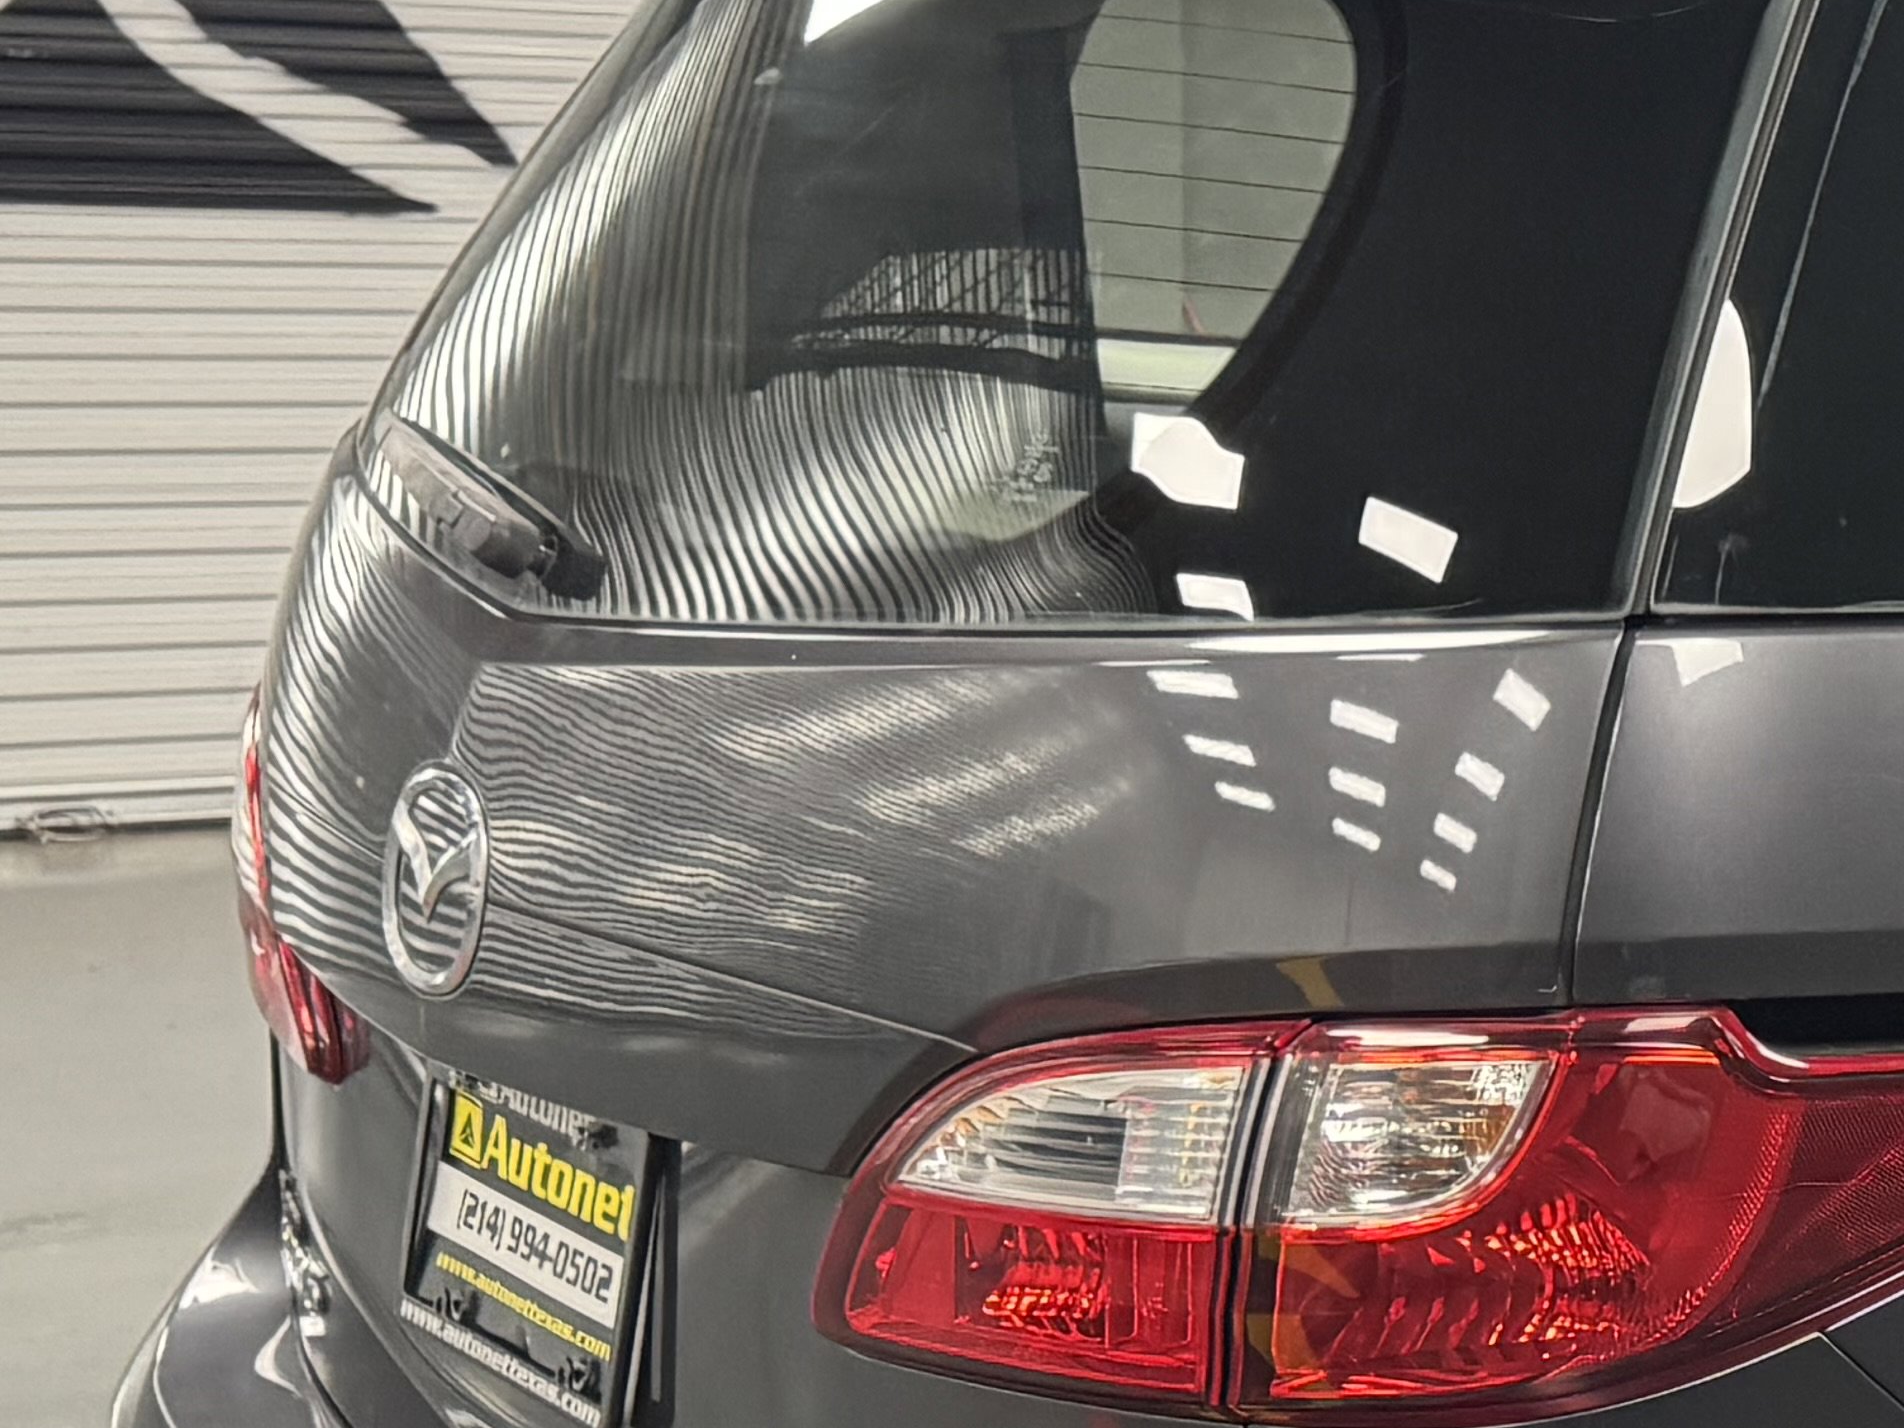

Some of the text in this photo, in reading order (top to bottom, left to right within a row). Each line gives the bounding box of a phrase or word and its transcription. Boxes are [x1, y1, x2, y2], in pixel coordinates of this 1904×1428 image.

[480, 1113, 635, 1242] Autonet
[436, 1251, 611, 1362] www.autonettexas.com
[456, 1188, 613, 1305] (214) 994-0502
[400, 1298, 601, 1428] www.autonettexas.com
